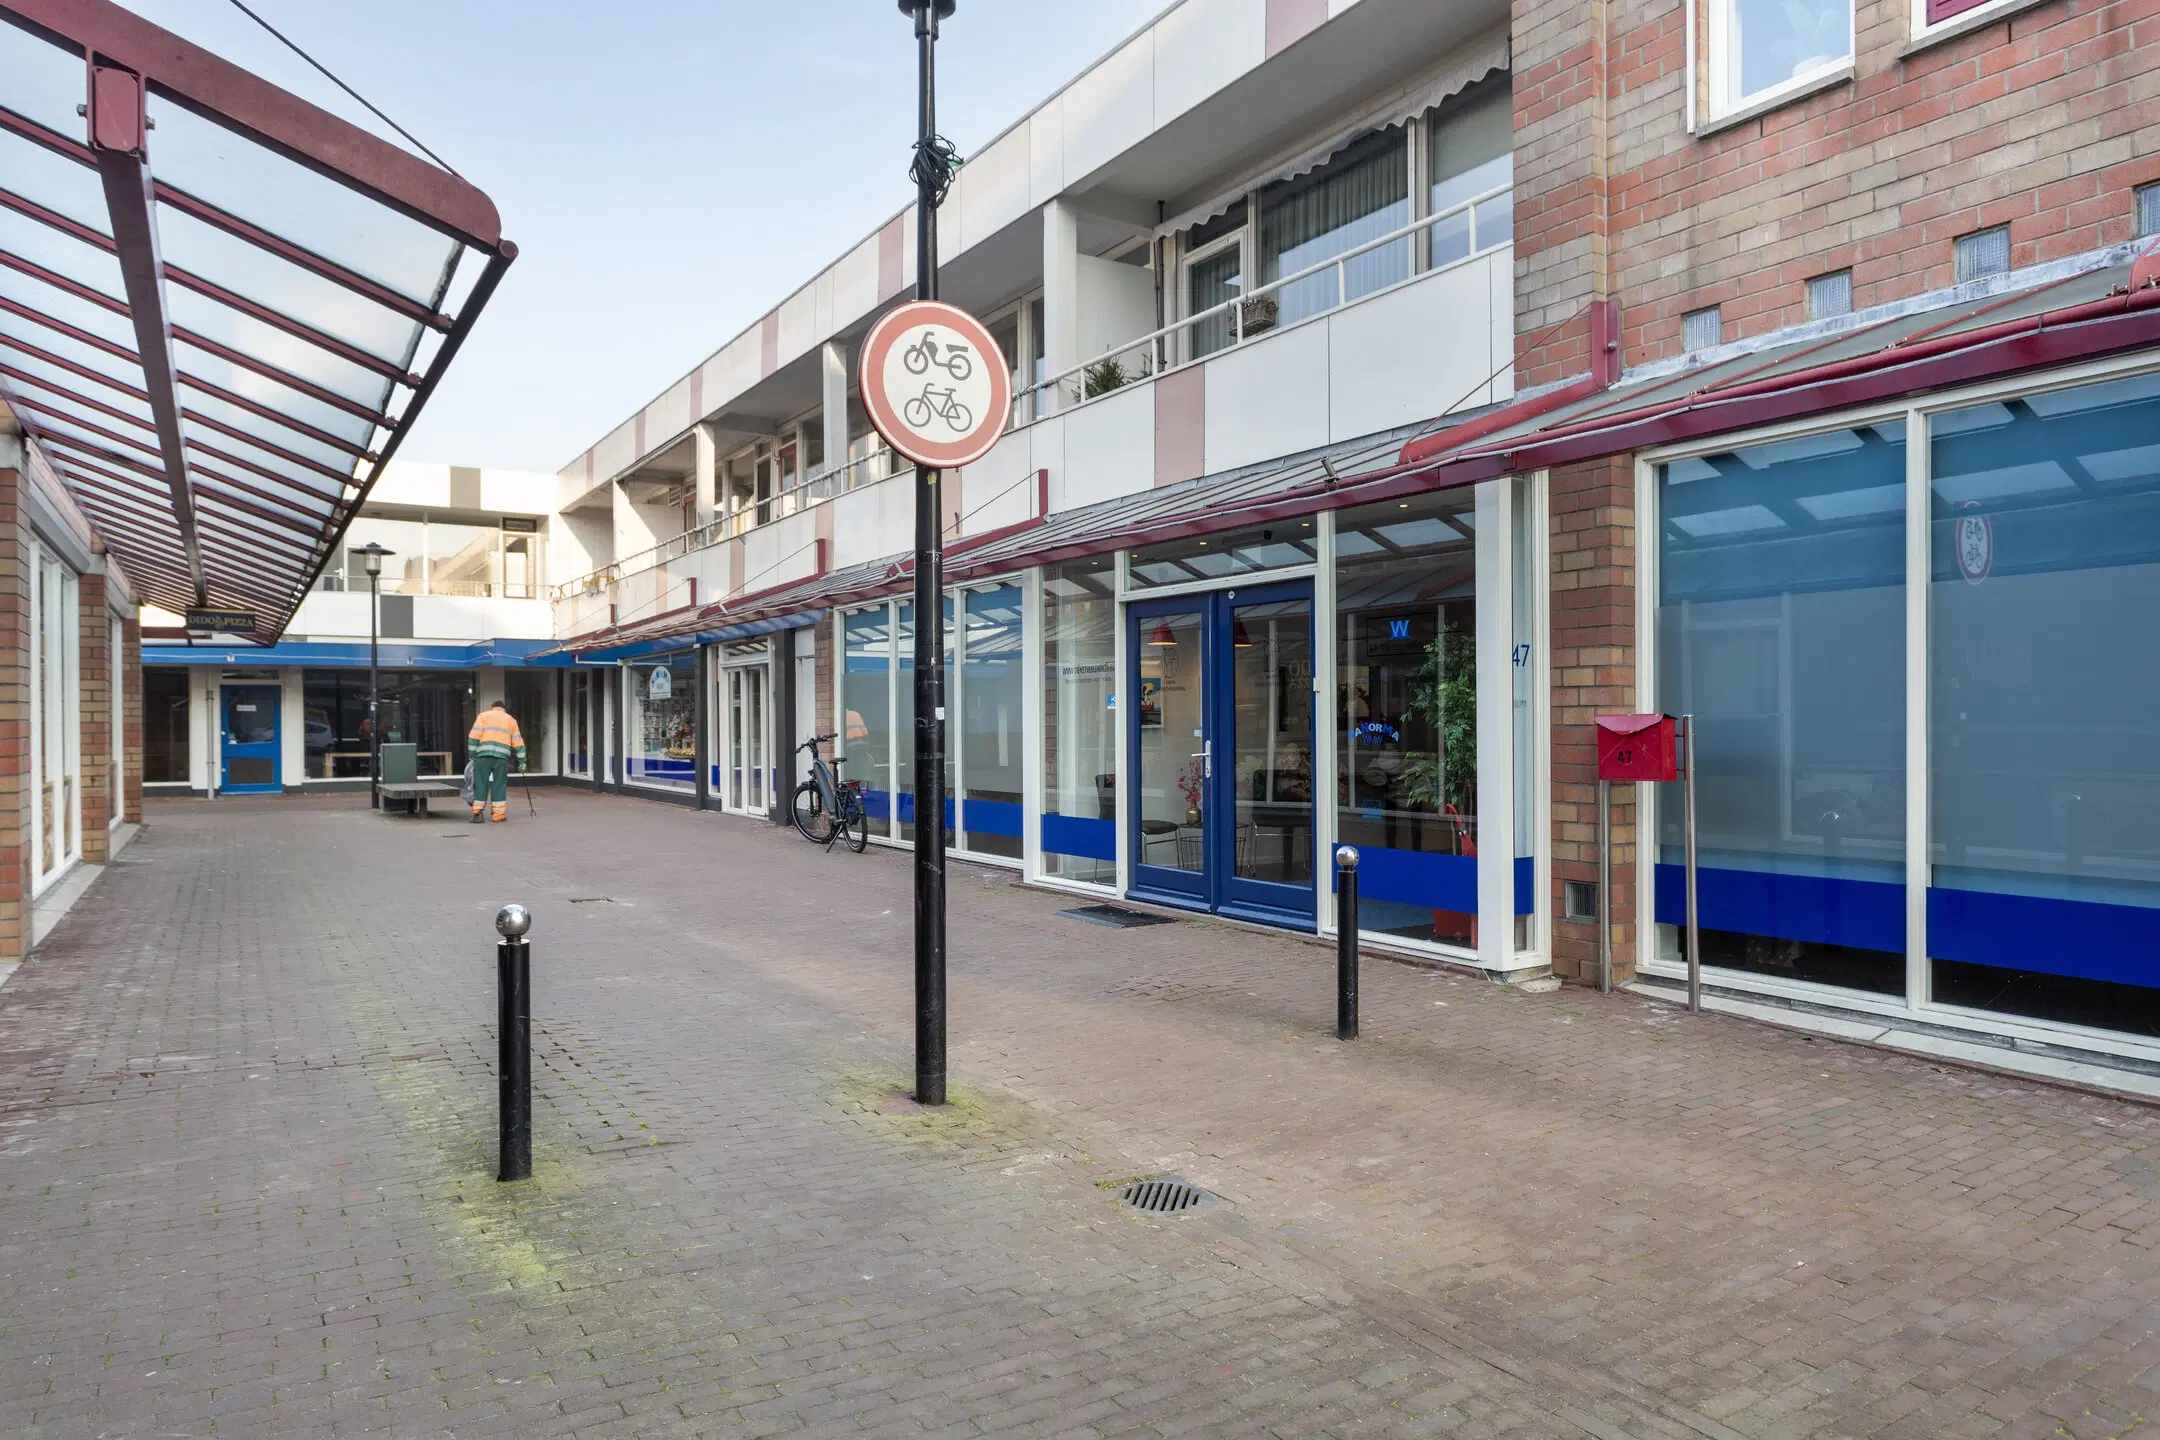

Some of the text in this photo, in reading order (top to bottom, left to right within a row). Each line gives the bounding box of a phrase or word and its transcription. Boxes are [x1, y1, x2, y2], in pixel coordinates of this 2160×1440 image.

[223, 617, 254, 627] PIZZA
[1512, 644, 1530, 667] 47
[1617, 750, 1632, 764] 47
